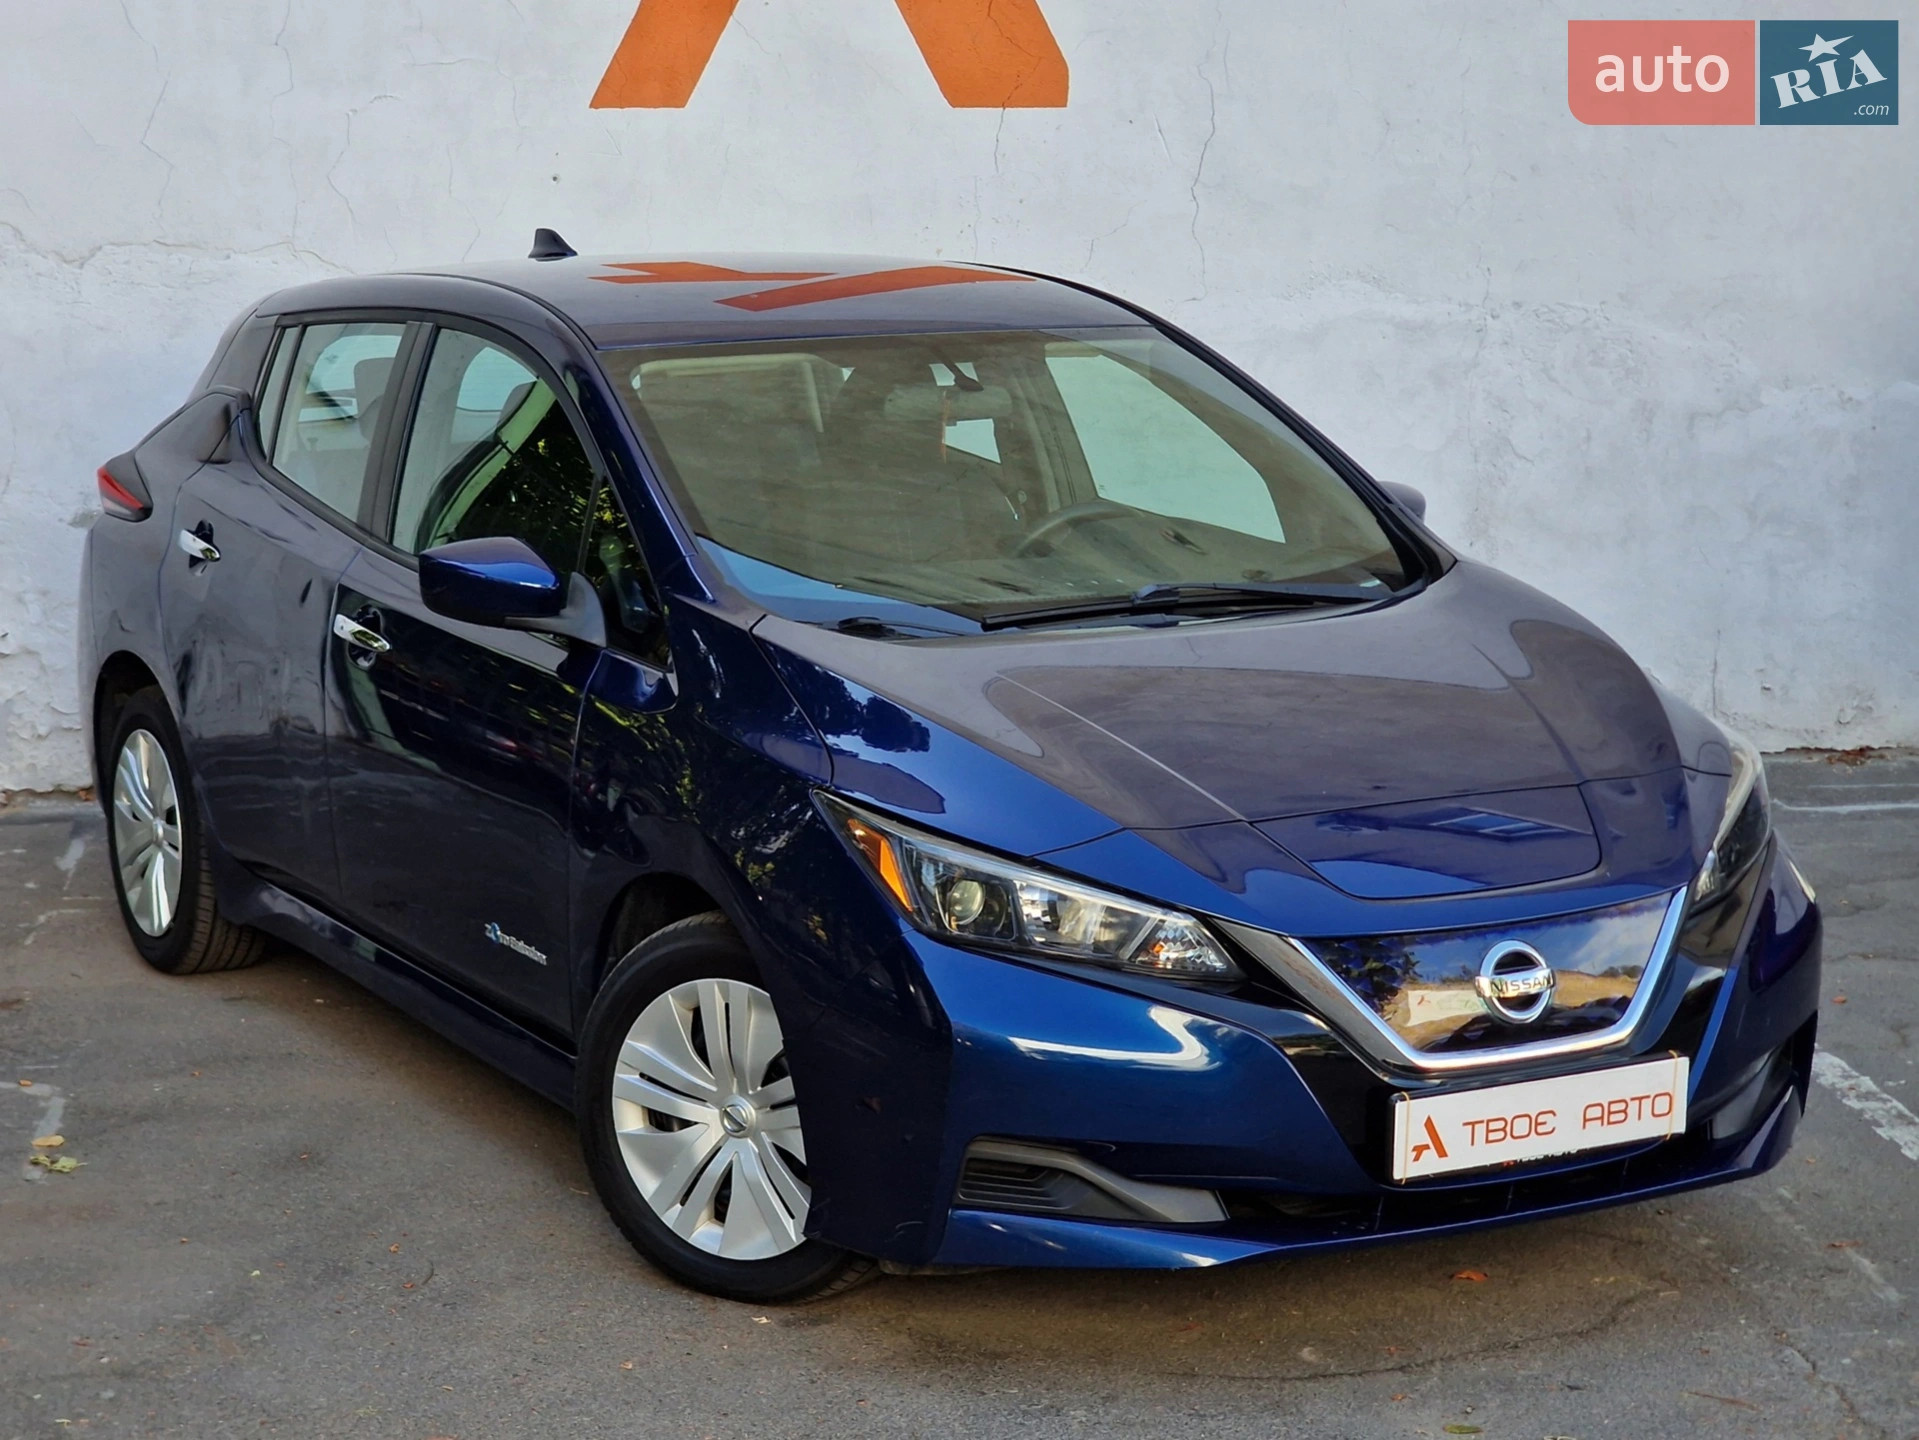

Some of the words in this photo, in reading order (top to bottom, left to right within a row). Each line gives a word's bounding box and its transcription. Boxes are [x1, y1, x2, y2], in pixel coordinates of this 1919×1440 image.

[1490, 974, 1552, 993] NISSAN
[1462, 1109, 1557, 1147] ТВОЄ
[1582, 1091, 1673, 1130] АВТО
